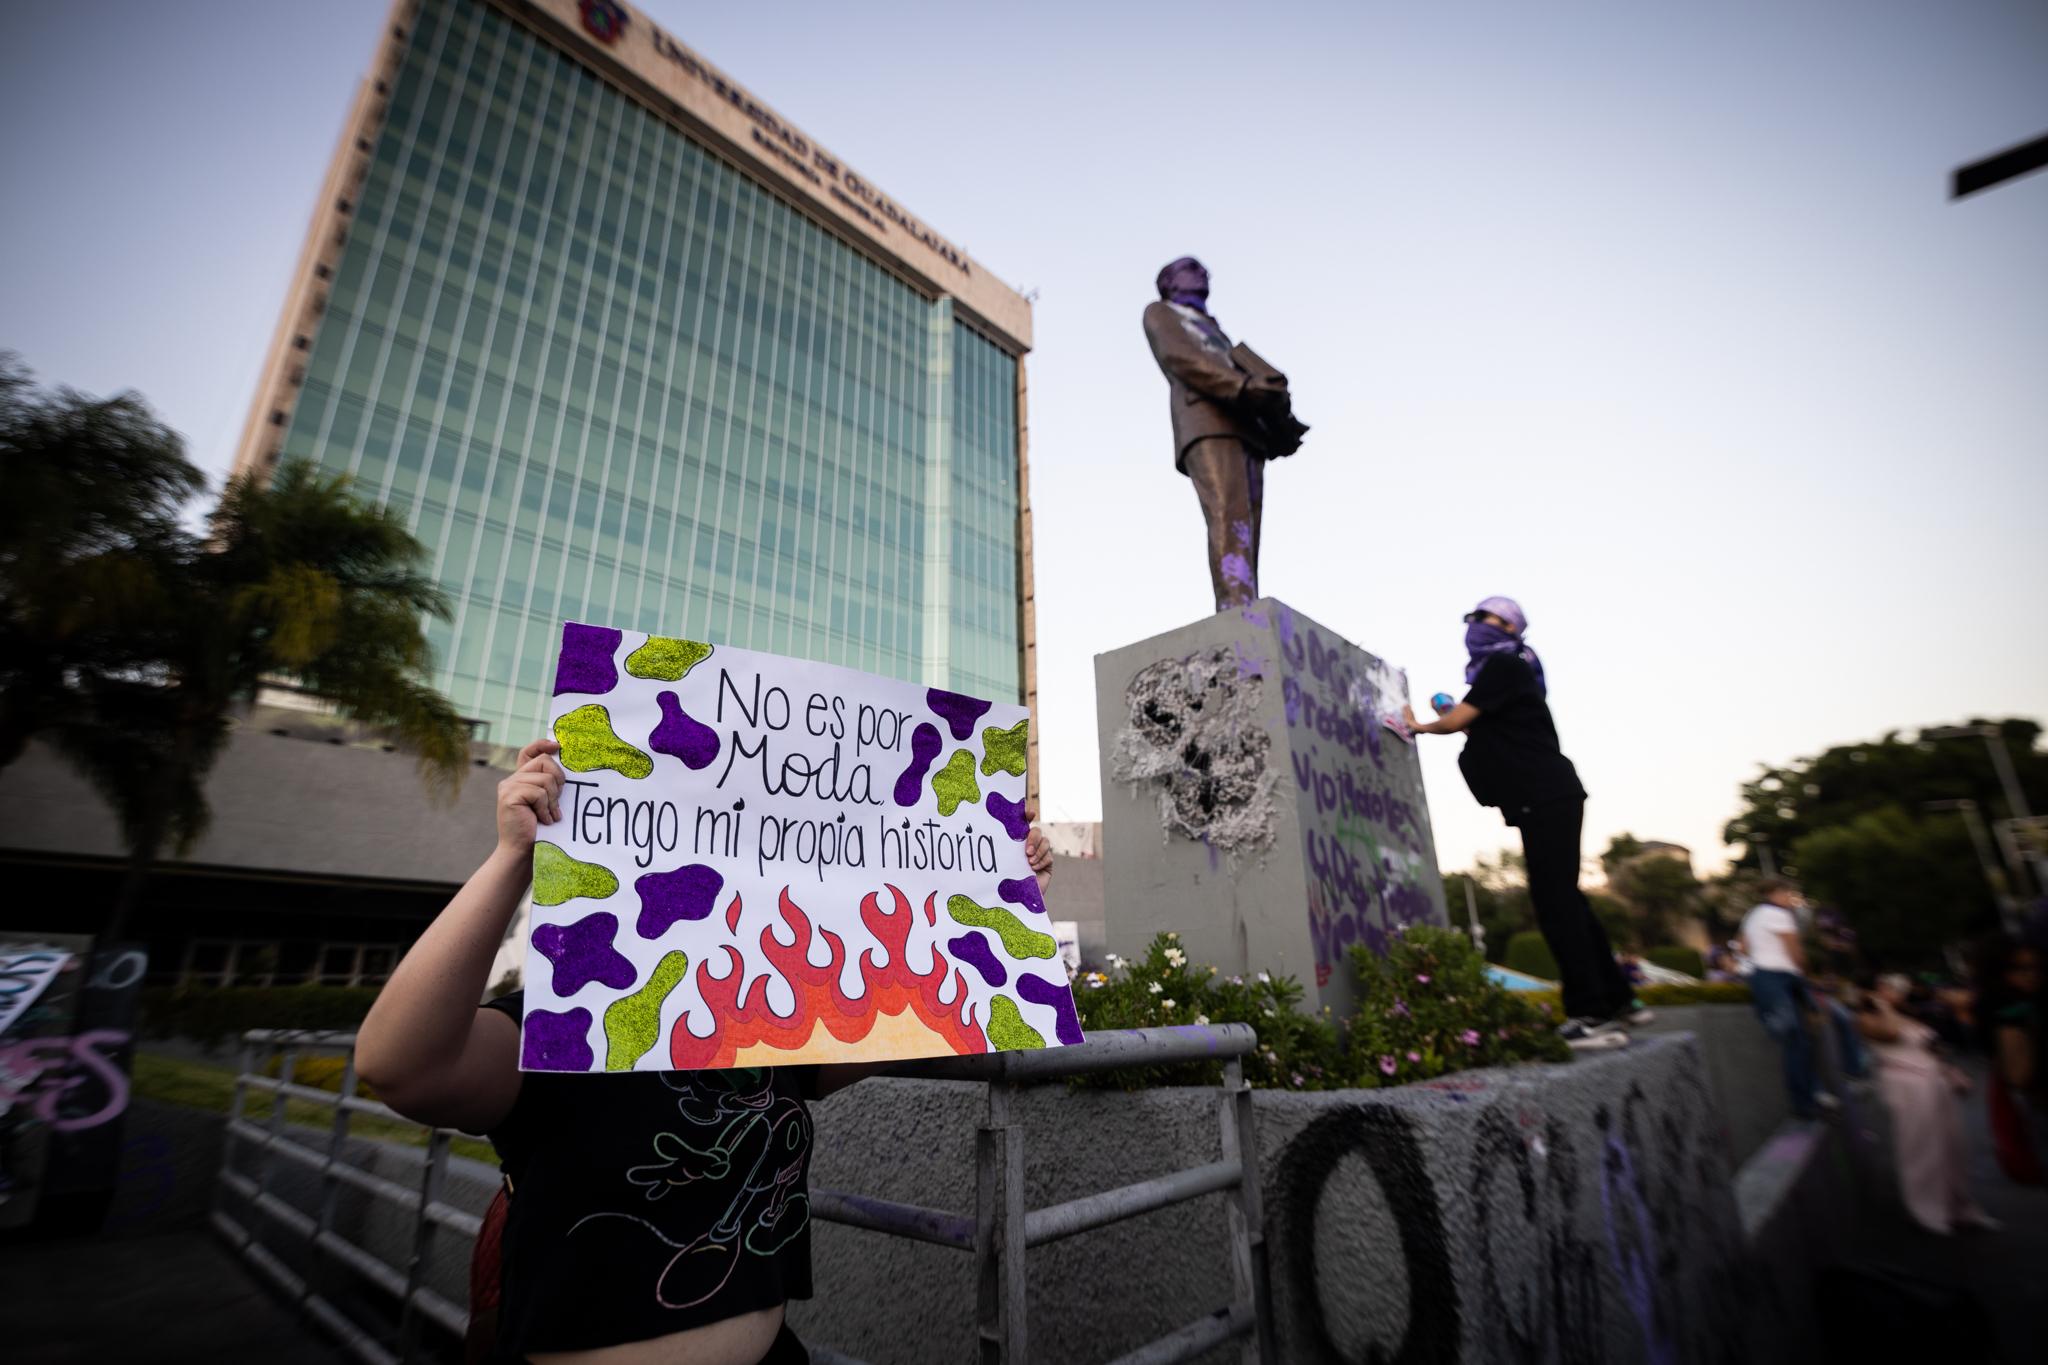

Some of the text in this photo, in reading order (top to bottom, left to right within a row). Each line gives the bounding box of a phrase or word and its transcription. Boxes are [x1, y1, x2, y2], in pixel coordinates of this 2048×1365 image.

[812, 147, 839, 179] DE
[844, 167, 971, 277] GUADALAJARA
[716, 667, 913, 757] No es por
[564, 779, 999, 883] Tengo mi propia historia
